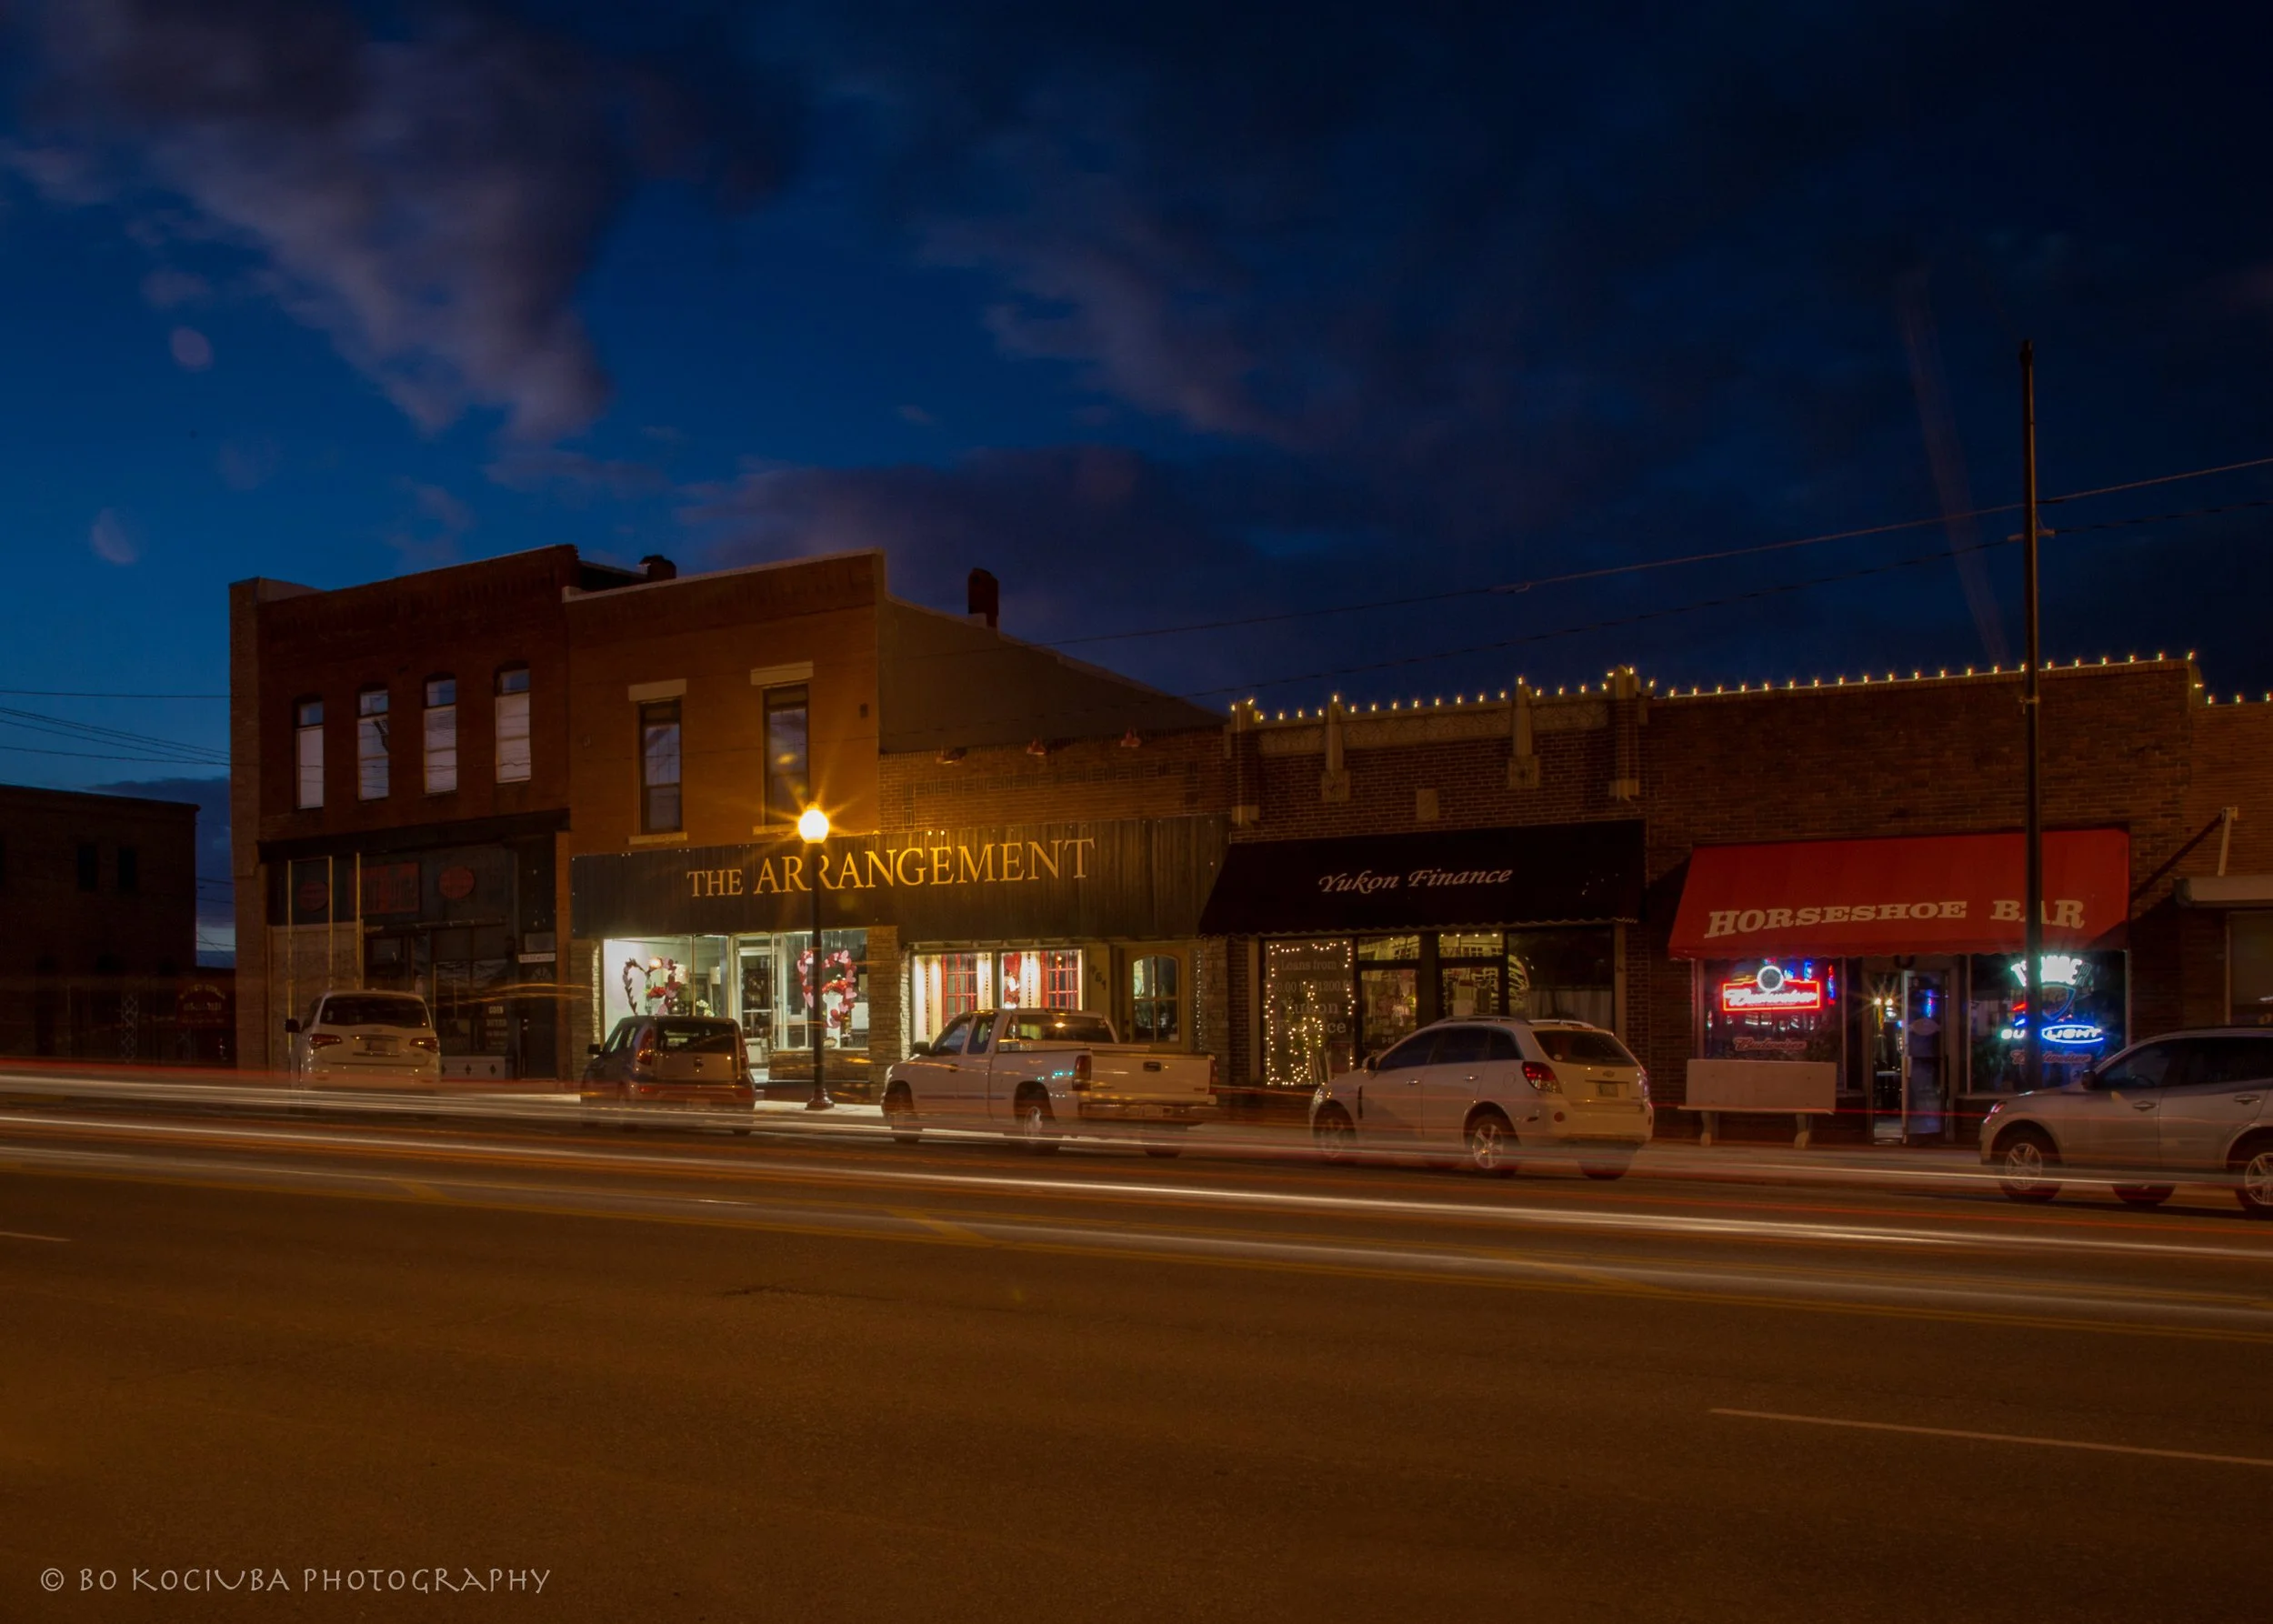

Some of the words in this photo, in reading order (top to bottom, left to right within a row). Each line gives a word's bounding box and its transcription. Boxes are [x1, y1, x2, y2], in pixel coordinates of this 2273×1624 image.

[686, 867, 744, 898] THE
[752, 837, 1096, 895] ARRANGEMENT
[1318, 869, 1400, 895] Yukon
[1407, 867, 1514, 888] Finance
[1703, 900, 1968, 939] HORSESHOE
[1280, 959, 1310, 971] Loans
[1313, 959, 1337, 971] from
